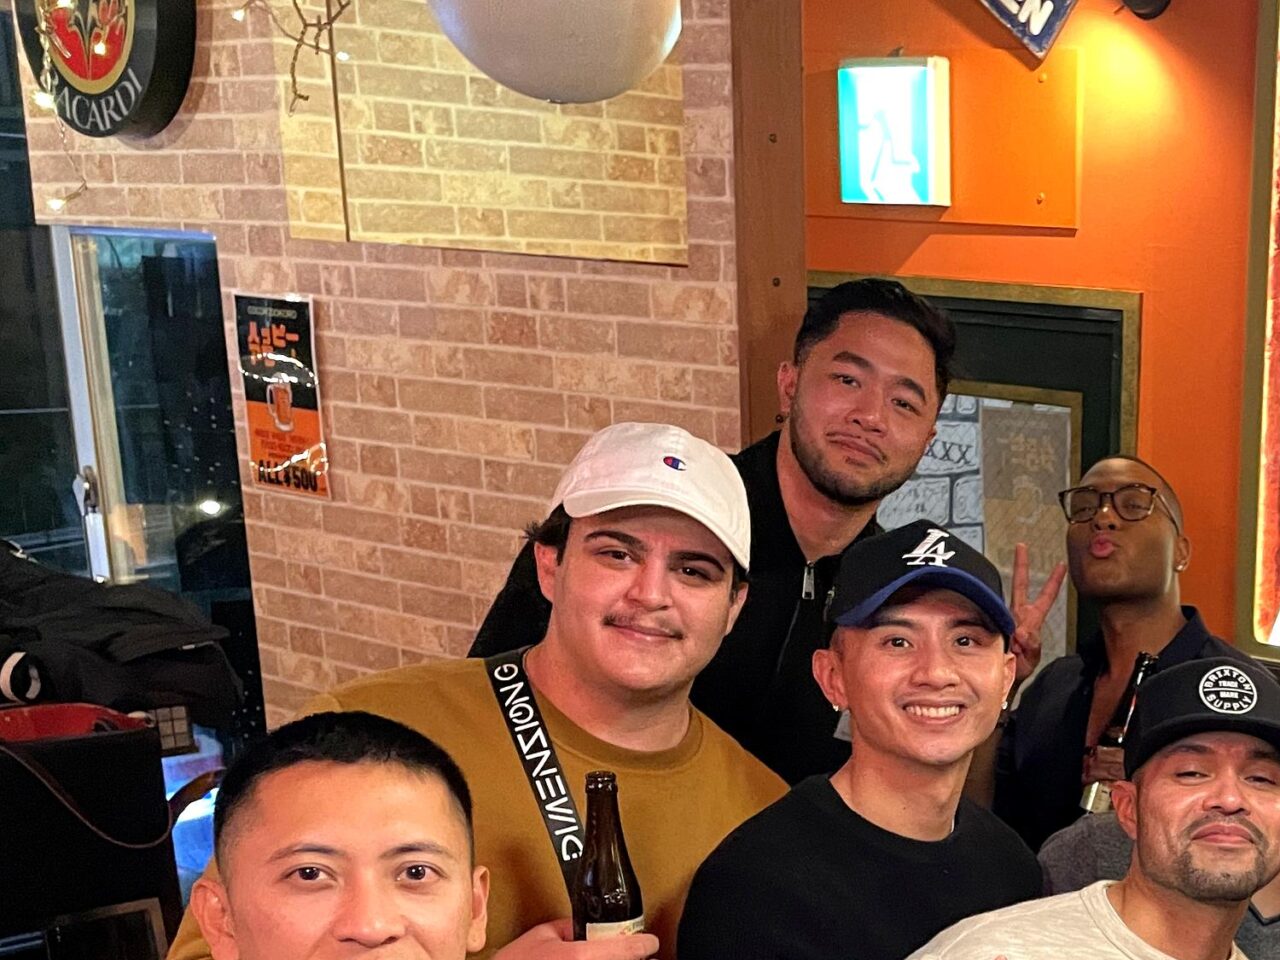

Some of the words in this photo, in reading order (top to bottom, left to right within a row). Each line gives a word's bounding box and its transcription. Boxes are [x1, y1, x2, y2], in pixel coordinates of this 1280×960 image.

[902, 528, 956, 567] LA
[1204, 669, 1252, 690] BRIXTON
[1206, 693, 1252, 711] SUPPLY
